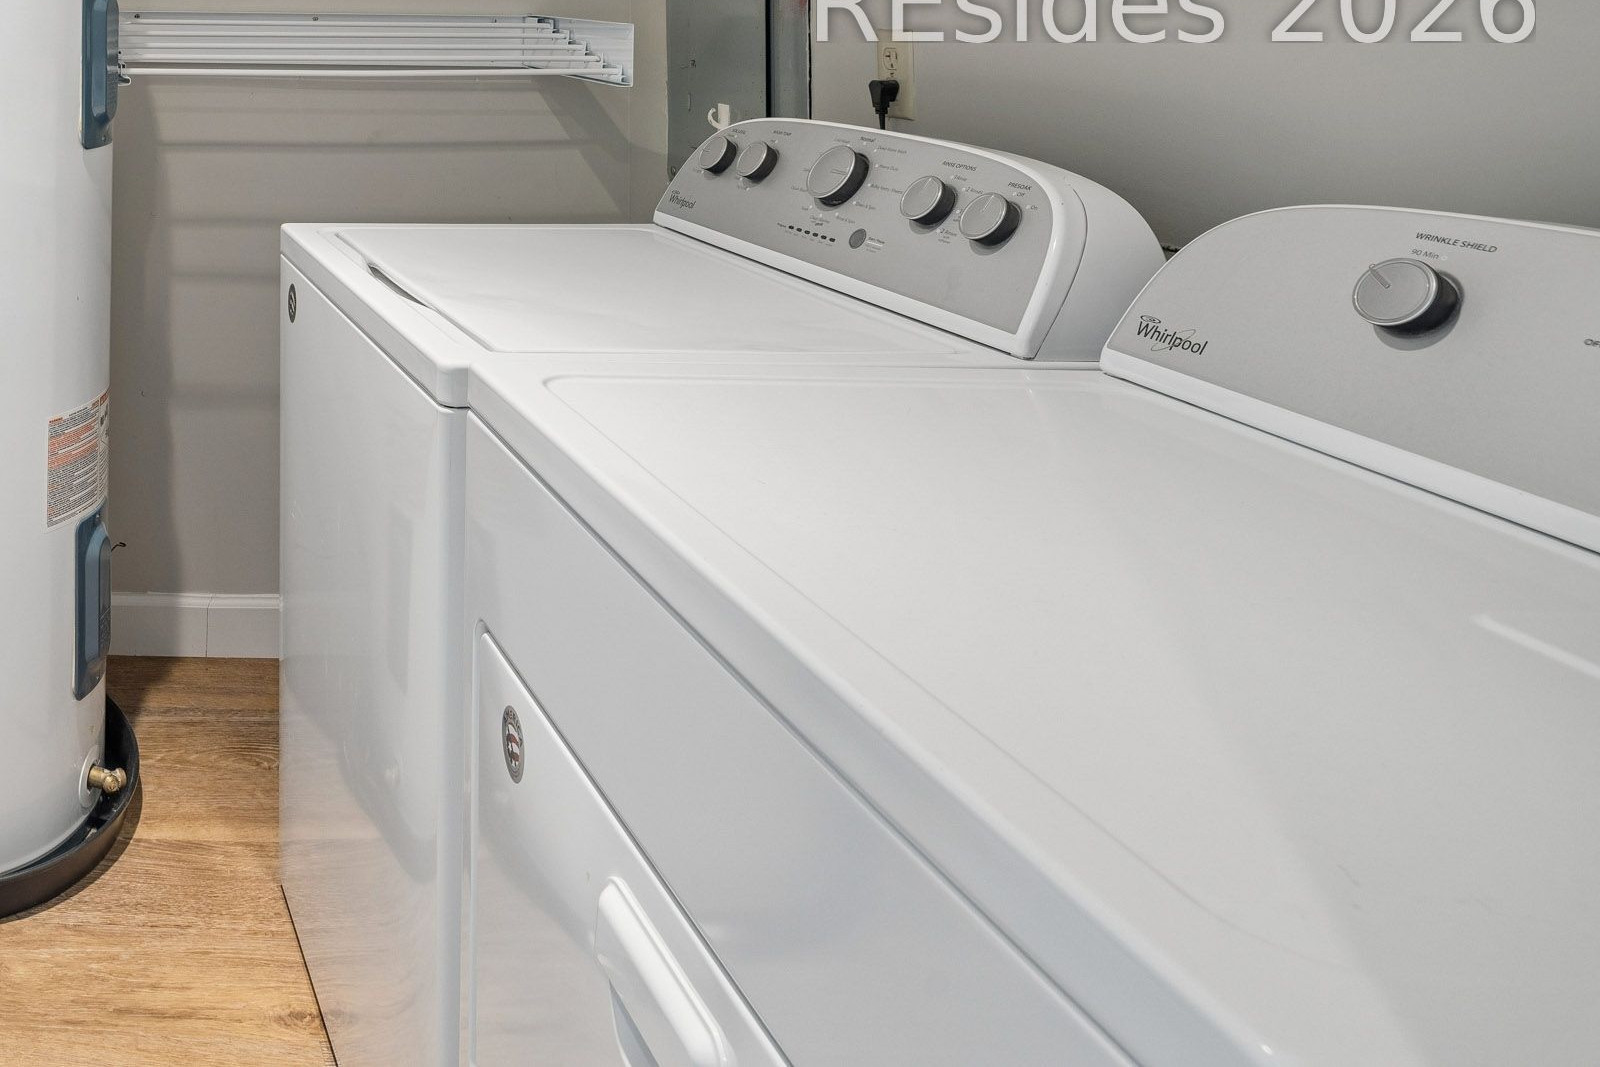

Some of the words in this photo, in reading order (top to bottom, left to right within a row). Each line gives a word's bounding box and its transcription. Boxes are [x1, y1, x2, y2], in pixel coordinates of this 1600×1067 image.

[955, 163, 977, 173] OPTIONS
[1007, 181, 1033, 192] PRESOAK
[668, 193, 697, 210] Whirlpool
[1415, 232, 1460, 247] WRINKLE
[1460, 240, 1498, 254] SHIELD
[1410, 248, 1423, 256] 90
[1422, 250, 1440, 261] Min
[1137, 321, 1209, 355] Whirlpool
